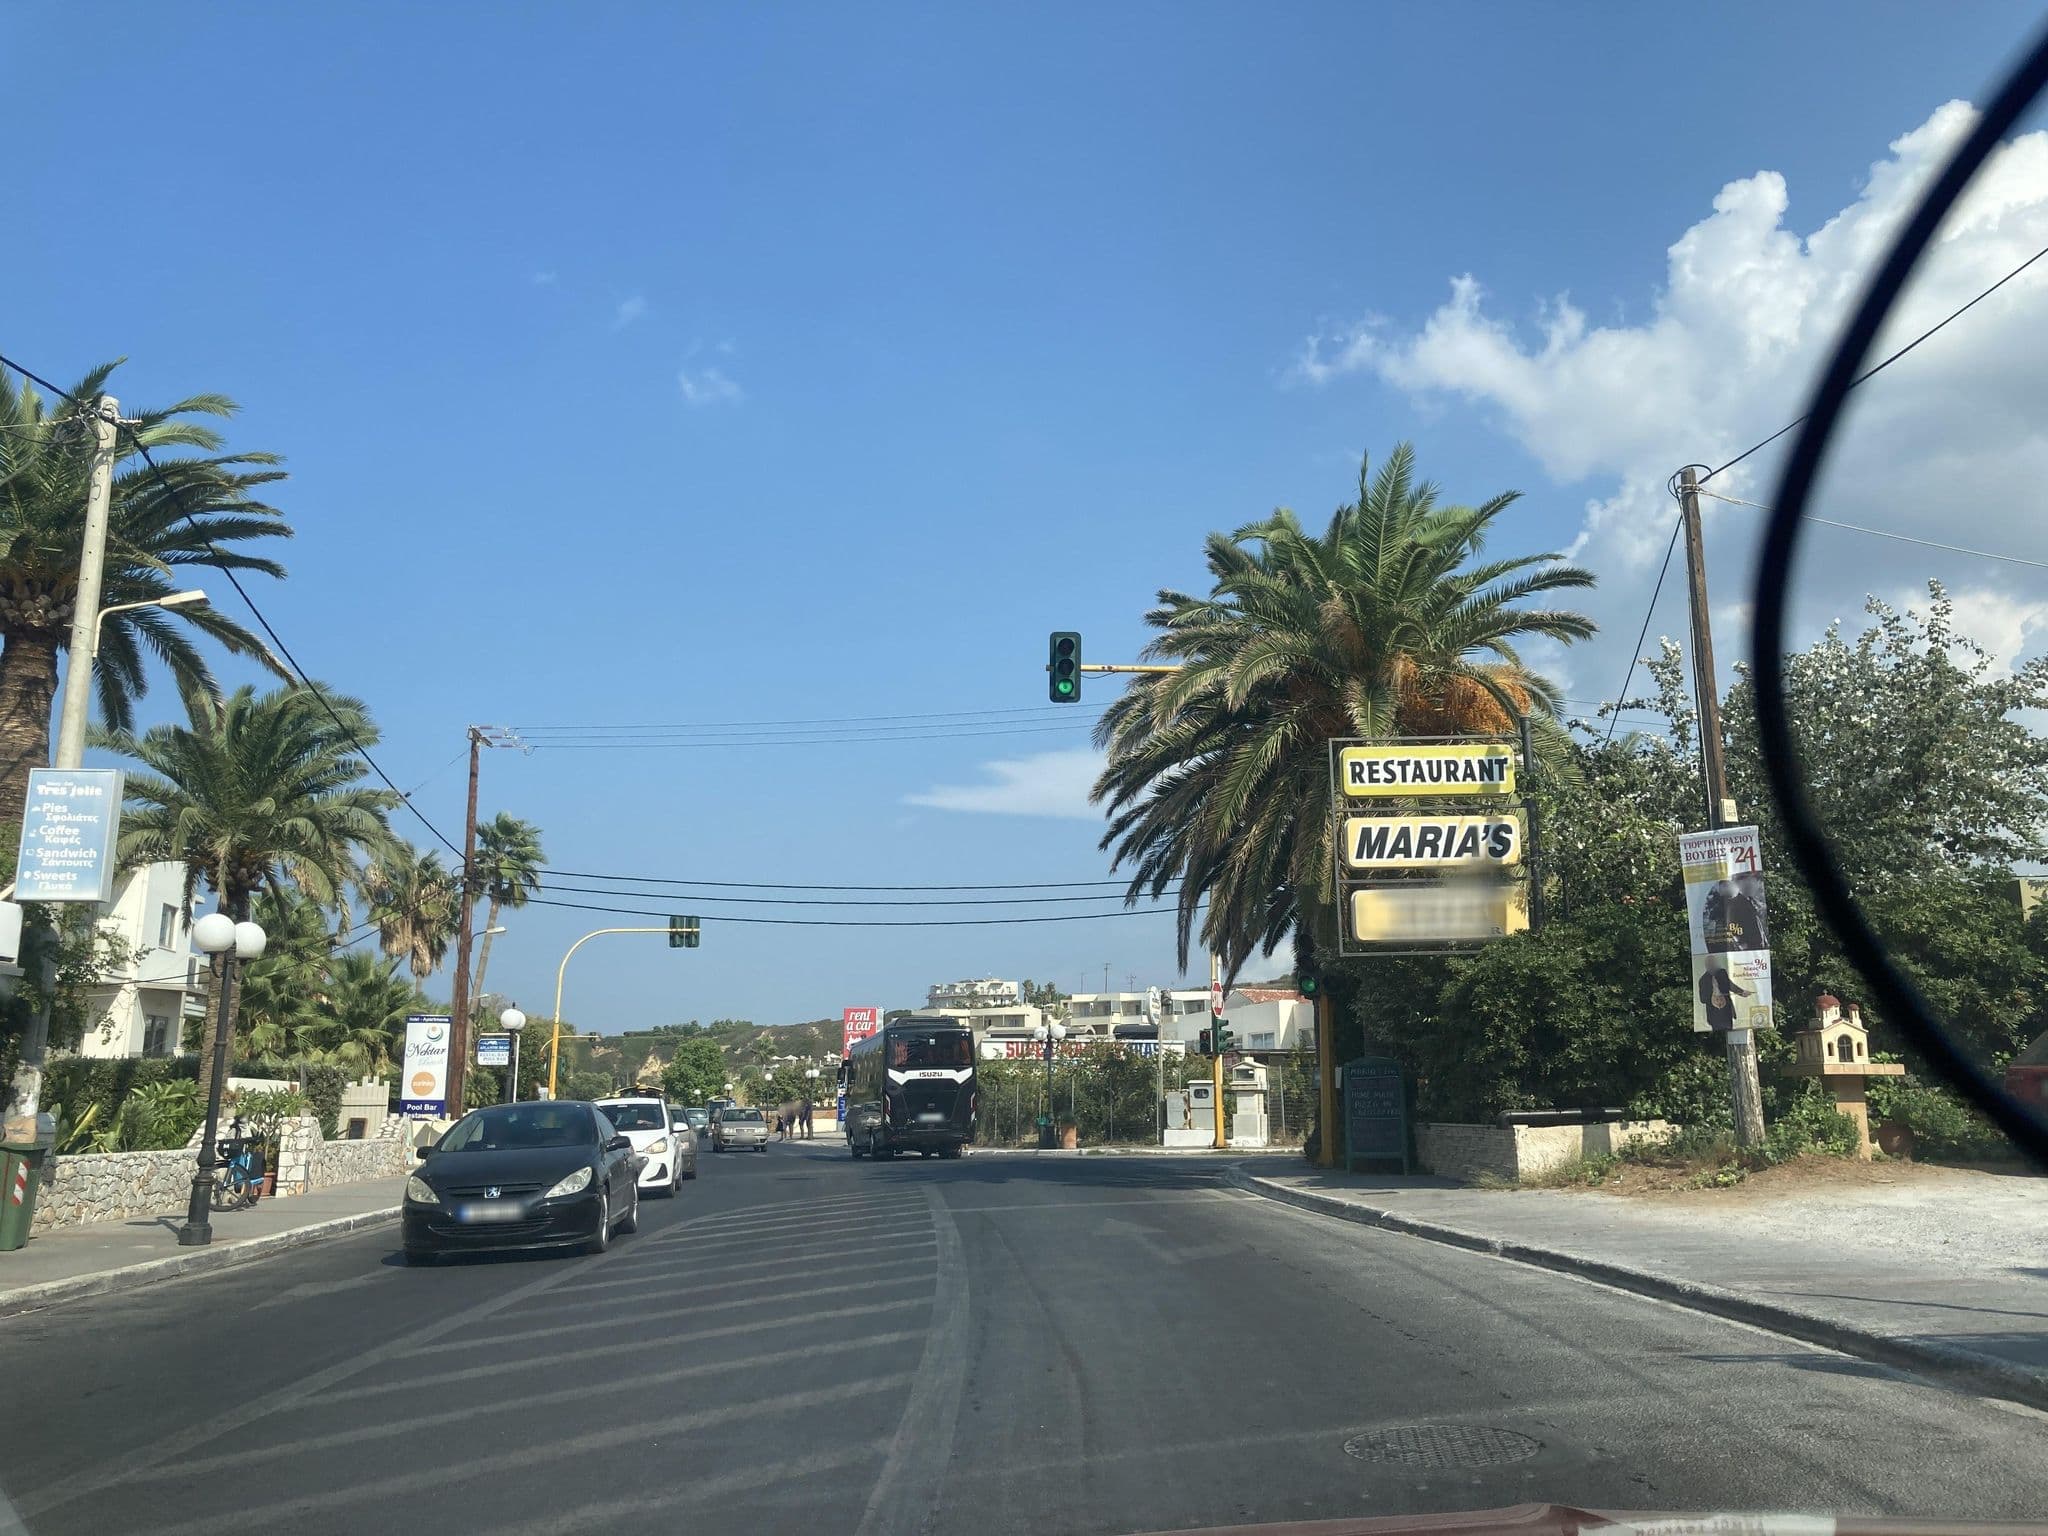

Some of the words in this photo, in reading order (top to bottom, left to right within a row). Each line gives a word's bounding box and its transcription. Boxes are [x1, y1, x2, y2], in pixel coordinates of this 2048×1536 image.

[1350, 758, 1509, 784] RESTAURANT
[42, 803, 68, 813] Pies
[45, 813, 100, 824] Σφολιάτες
[39, 825, 80, 836] Coffee
[1355, 823, 1513, 860] MARIA'S
[1716, 834, 1754, 846] ΚΡΑΣΙΟΥ
[36, 847, 97, 858] Sandwich
[1685, 848, 1727, 862] ΒΟΥΒΕΣ
[33, 870, 78, 880] Sweets
[847, 1022, 854, 1031] a
[856, 1022, 875, 1031] car
[406, 1042, 447, 1058] Nektar
